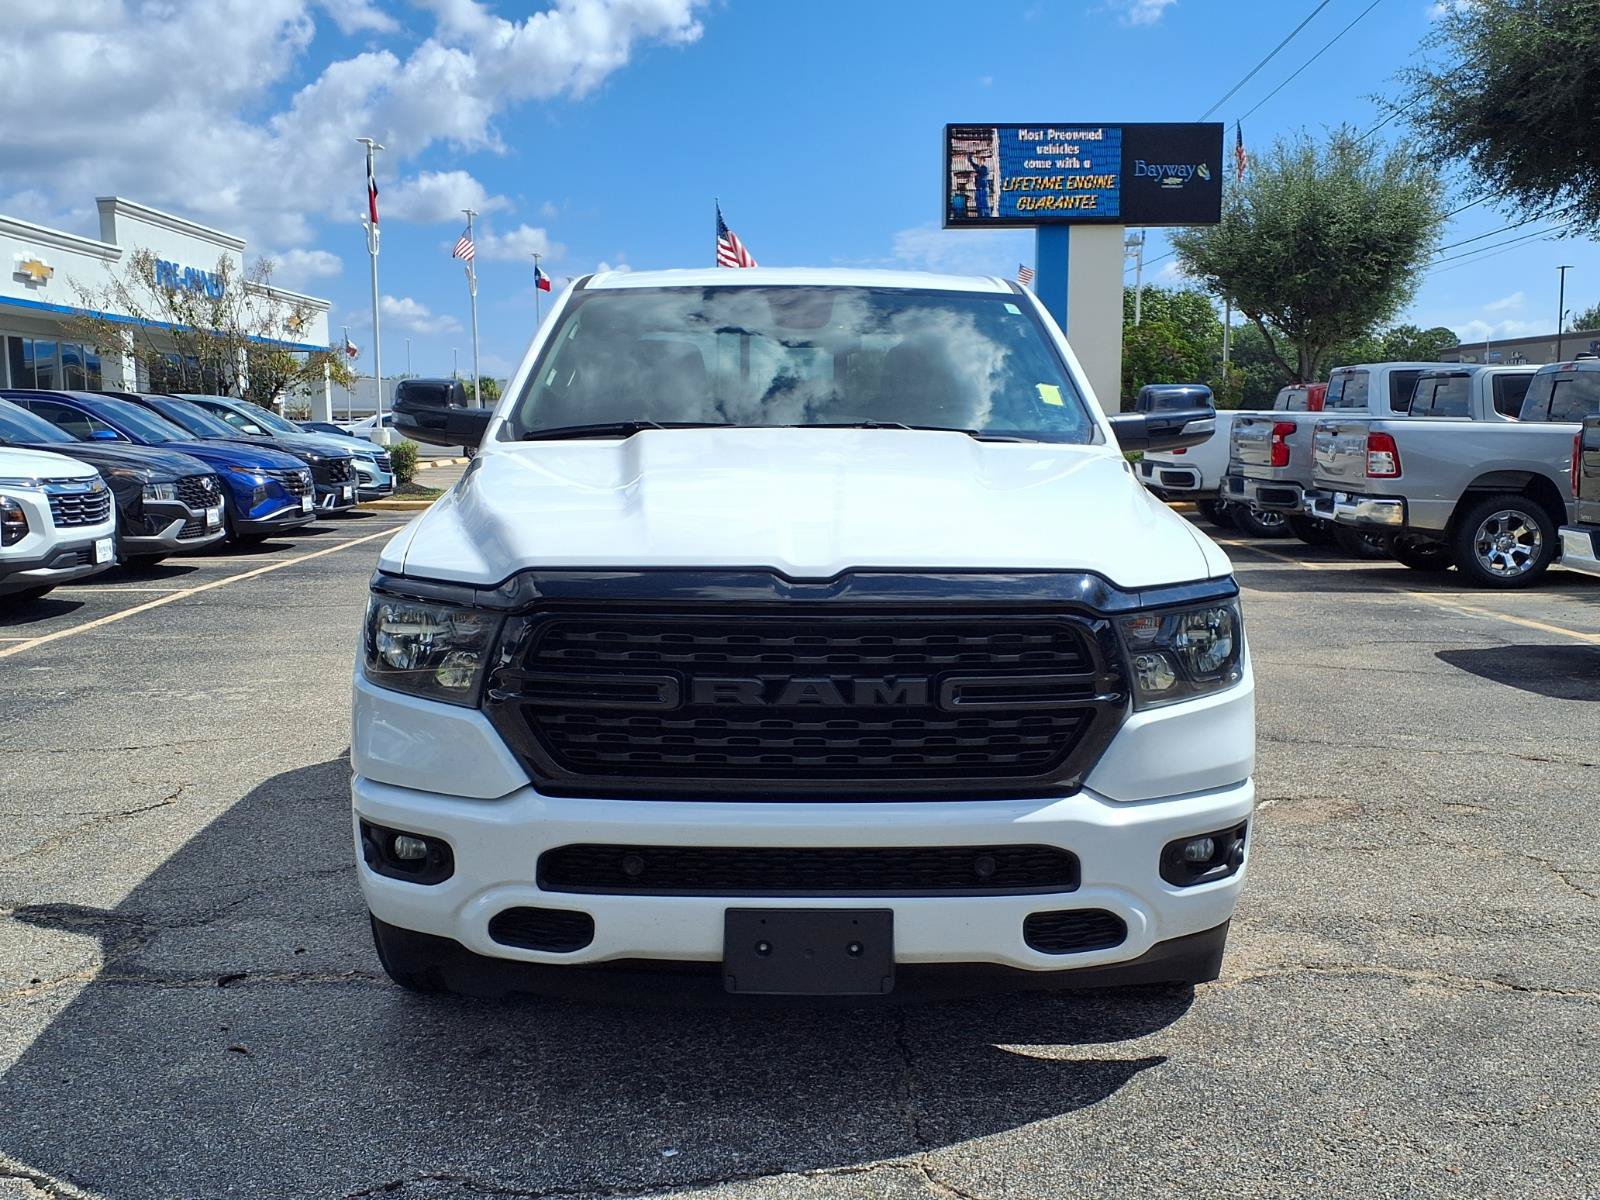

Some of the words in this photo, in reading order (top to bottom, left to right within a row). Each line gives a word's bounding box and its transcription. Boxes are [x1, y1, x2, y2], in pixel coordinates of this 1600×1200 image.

[1018, 128, 1043, 140] Most
[1047, 129, 1102, 140] Preowned
[1036, 143, 1080, 154] vehicles
[1023, 159, 1052, 168] come
[1055, 157, 1080, 168] with
[1083, 159, 1091, 168] a
[1134, 159, 1196, 182] Bayway
[1002, 175, 1064, 191] LIFETIME
[1066, 174, 1117, 190] ENGINE
[1016, 194, 1098, 210] GUARANTEE
[691, 676, 928, 706] RAM
